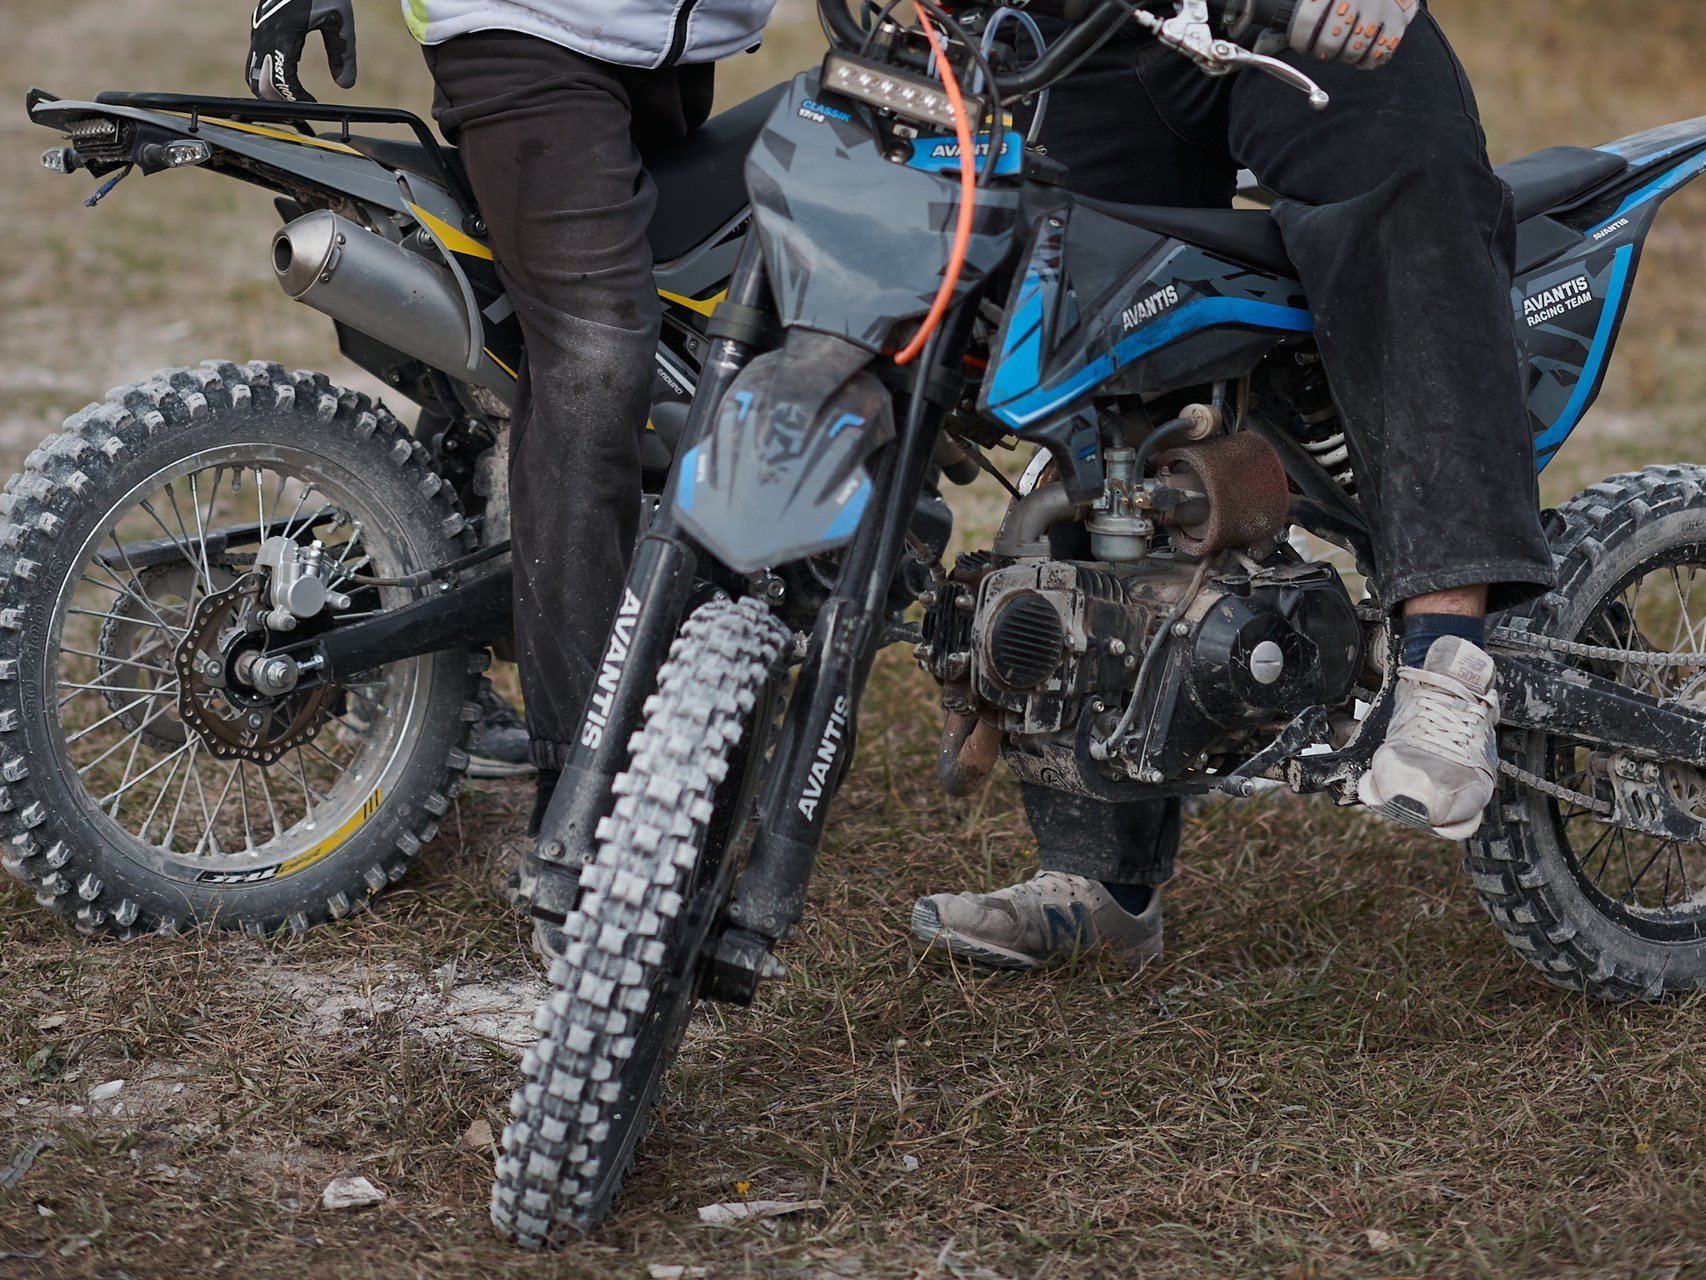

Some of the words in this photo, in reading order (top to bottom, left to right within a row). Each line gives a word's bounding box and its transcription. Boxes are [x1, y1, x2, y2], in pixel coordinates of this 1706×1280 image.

[802, 99, 851, 122] CLASSIK
[1593, 218, 1629, 240] AVANTIS
[1122, 284, 1179, 331] AVANTIS
[1523, 276, 1588, 315] AVANTIS
[1526, 303, 1566, 327] RACING
[1564, 291, 1592, 310] TEAM
[655, 367, 684, 396] ENDURO
[580, 587, 641, 750] AVANTIS
[798, 695, 850, 822] AVANTIS
